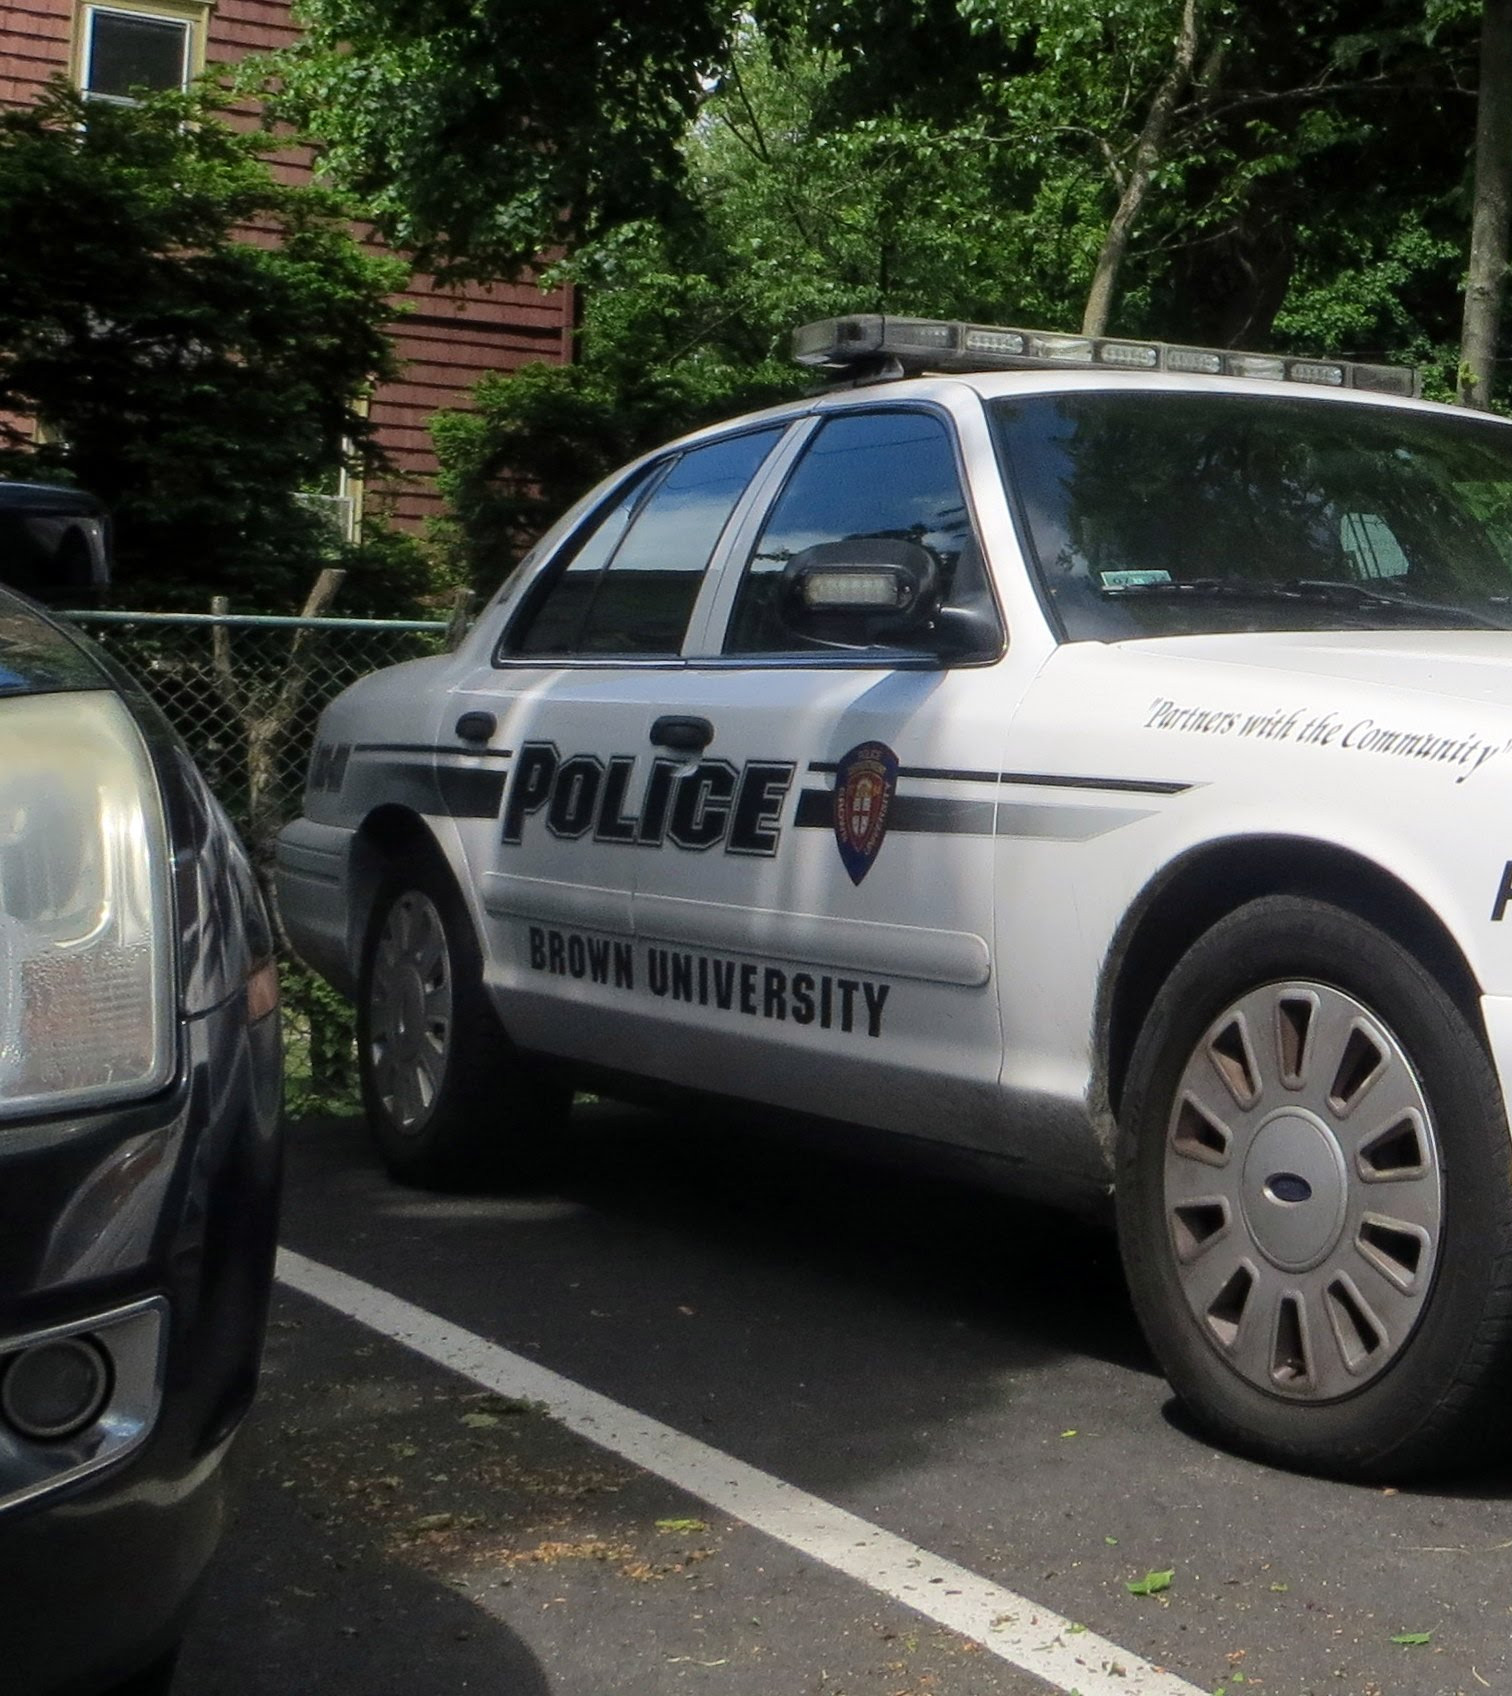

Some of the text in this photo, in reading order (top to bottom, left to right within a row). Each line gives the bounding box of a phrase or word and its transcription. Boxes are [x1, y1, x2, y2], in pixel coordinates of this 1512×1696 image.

[1144, 697, 1243, 735] "Partners
[1238, 708, 1307, 741] with
[1296, 711, 1343, 746] the
[501, 740, 798, 858] POLICE
[529, 926, 891, 1038] BROWN UNIVERSITY
